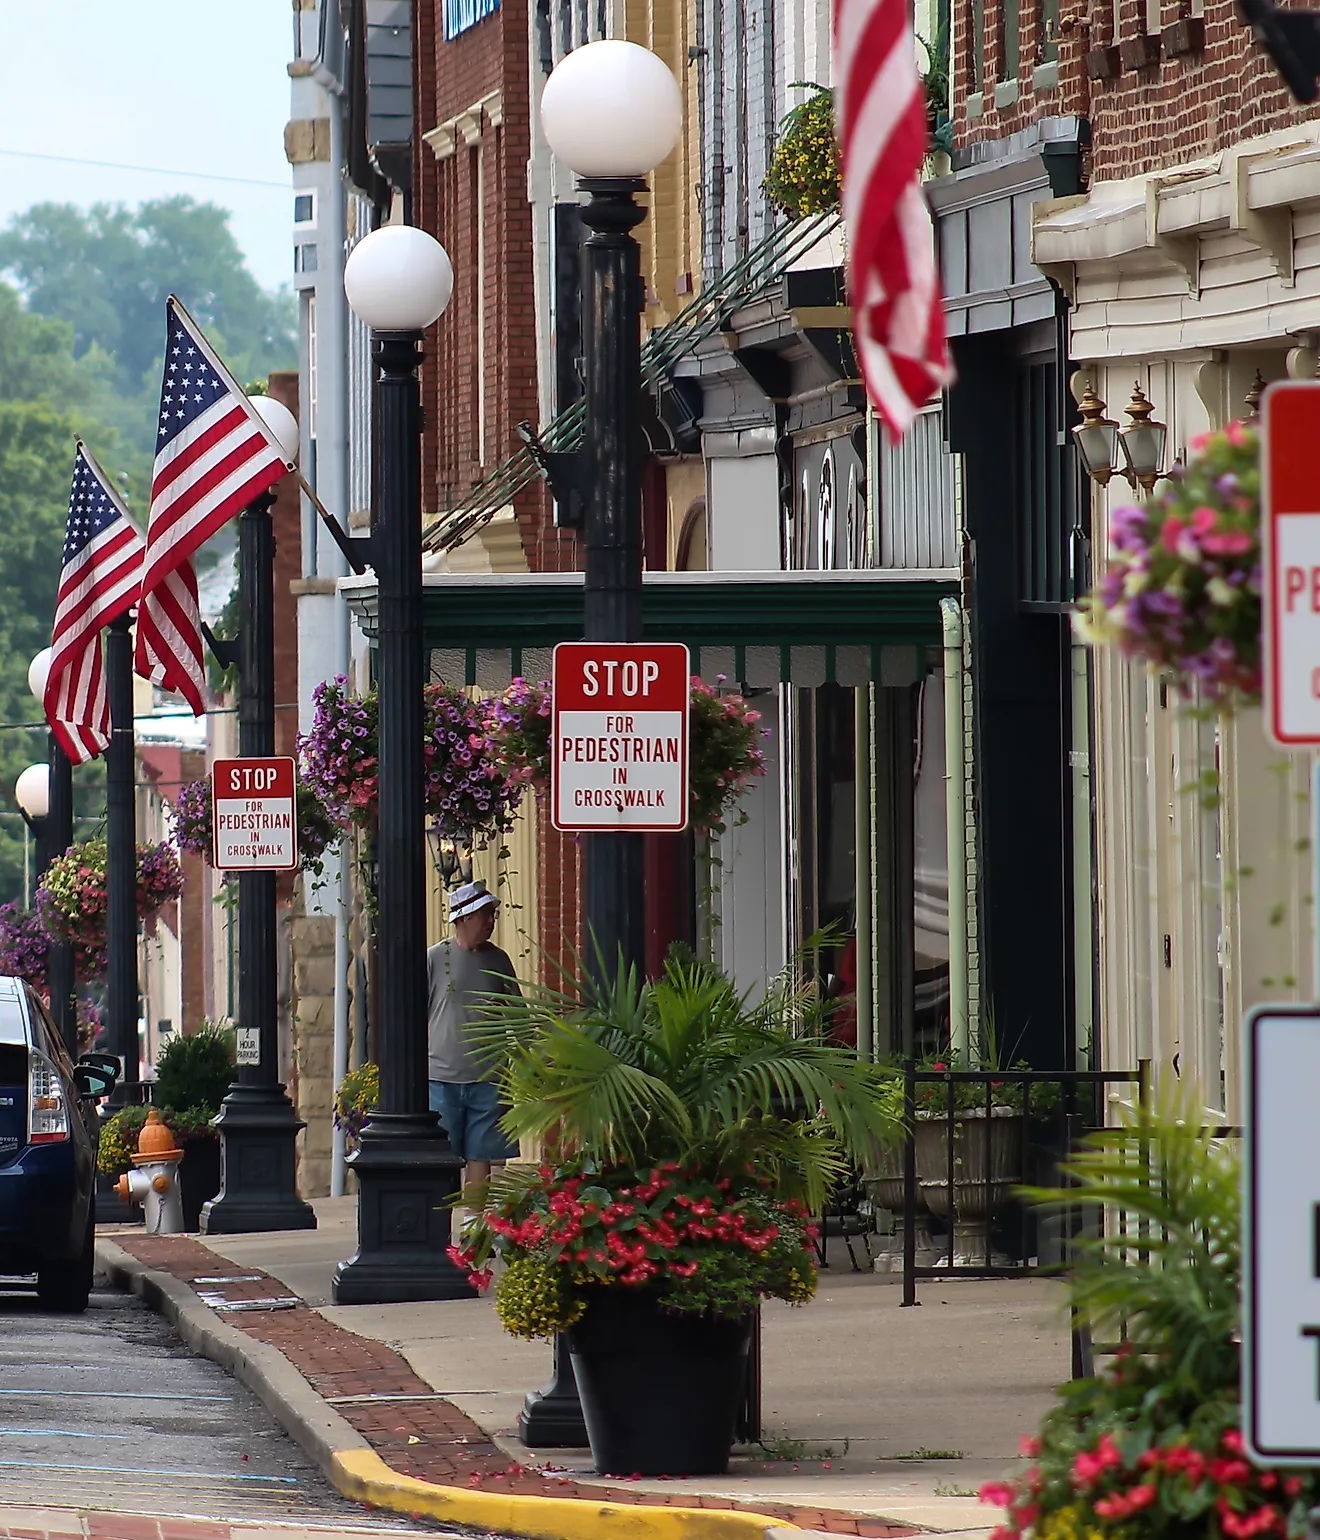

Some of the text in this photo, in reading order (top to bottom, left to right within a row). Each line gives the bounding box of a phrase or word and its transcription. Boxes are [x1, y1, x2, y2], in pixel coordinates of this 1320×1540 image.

[583, 660, 659, 697] STOP
[606, 716, 634, 733] FOR
[562, 737, 679, 763] PEDESTRIAN
[230, 768, 277, 791] STOP
[612, 768, 627, 784] IN
[574, 789, 665, 807] CROSSWALK
[245, 801, 263, 812] FOR
[220, 813, 290, 830] PEDESTRIAN
[250, 832, 260, 842] IN
[227, 844, 283, 856] CROSSWALK
[239, 1040, 256, 1049] HOUR
[237, 1050, 259, 1059] PARKING
